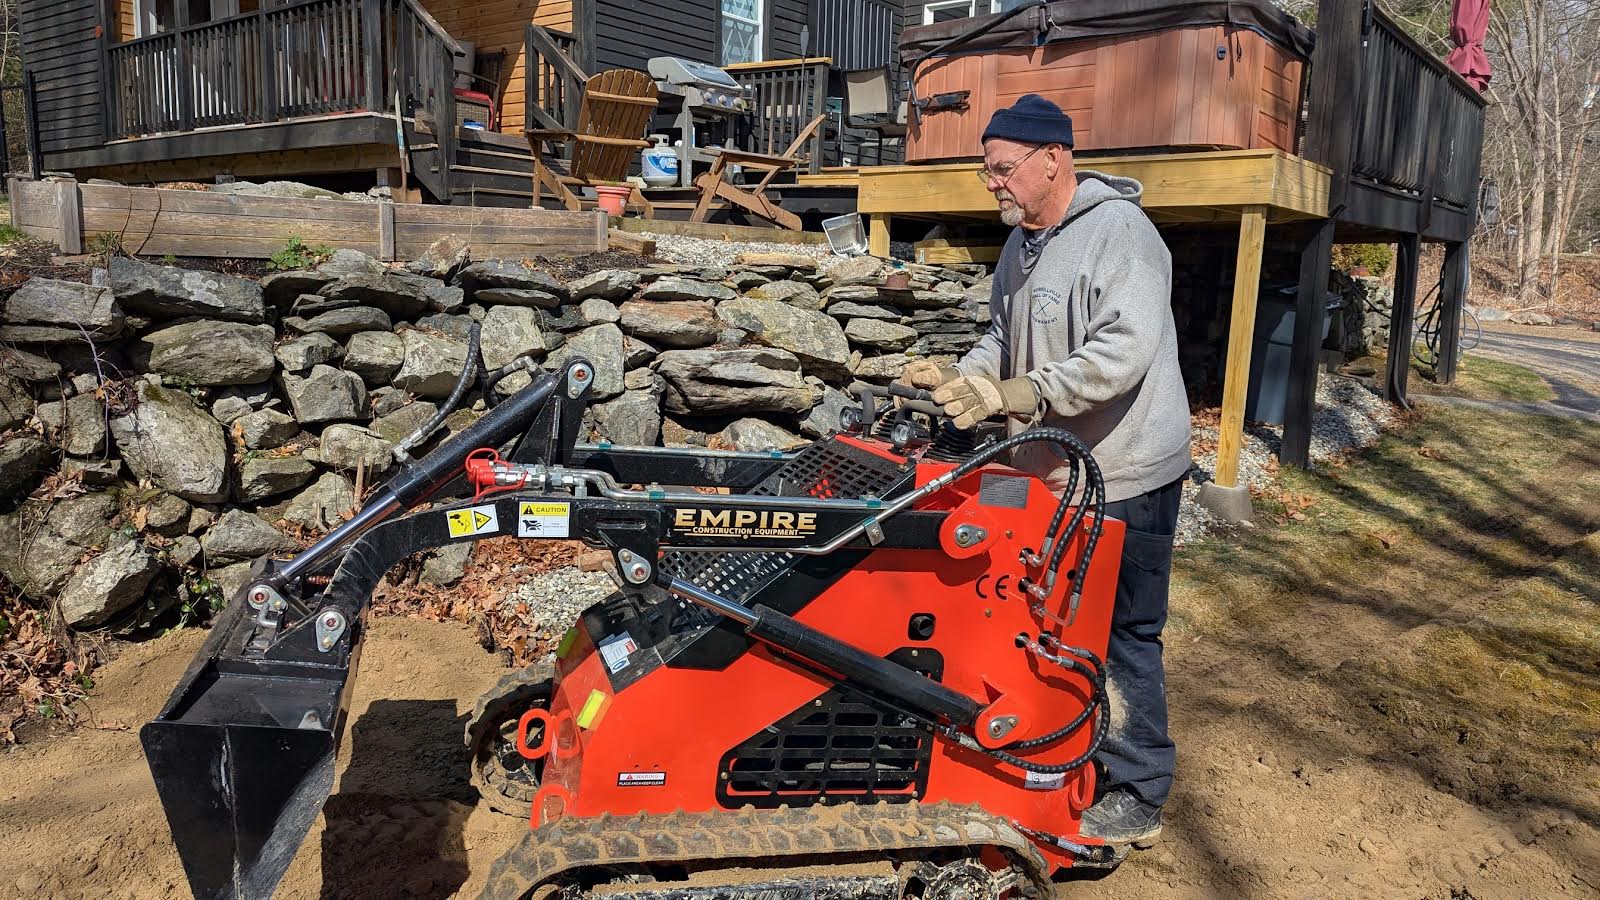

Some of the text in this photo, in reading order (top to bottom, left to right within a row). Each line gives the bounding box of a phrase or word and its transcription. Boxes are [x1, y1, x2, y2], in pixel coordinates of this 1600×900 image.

[674, 508, 817, 530] EMPIRE
[692, 526, 799, 536] CONSTRUCTION EQUIPMENT
[976, 574, 1010, 600] CE
